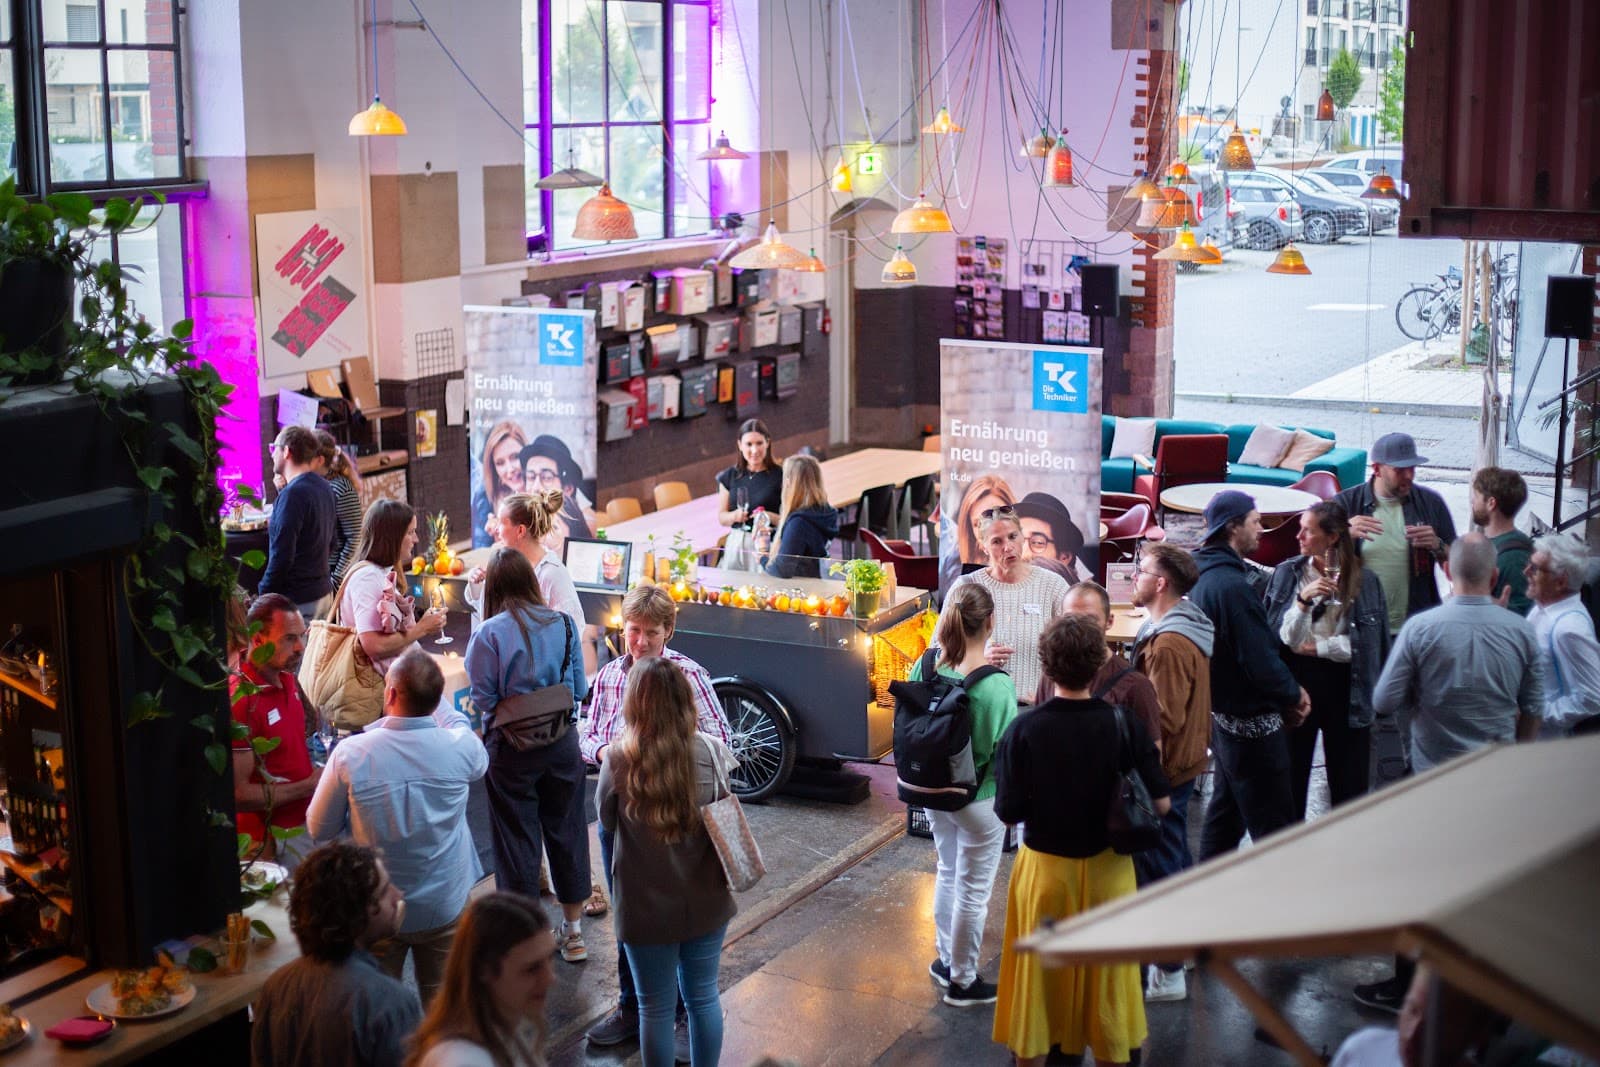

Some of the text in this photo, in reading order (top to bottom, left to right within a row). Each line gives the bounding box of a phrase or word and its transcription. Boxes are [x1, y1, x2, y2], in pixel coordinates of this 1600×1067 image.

[546, 323, 575, 349] TK
[475, 374, 553, 395] Ernährung
[1043, 362, 1077, 393] TK
[1043, 385, 1054, 393] Die
[1043, 393, 1077, 402] Techniker
[475, 398, 576, 416] neu genießen
[951, 419, 1048, 448] Ernährung
[950, 448, 1075, 470] neu genießen
[950, 472, 972, 483] tk.de
